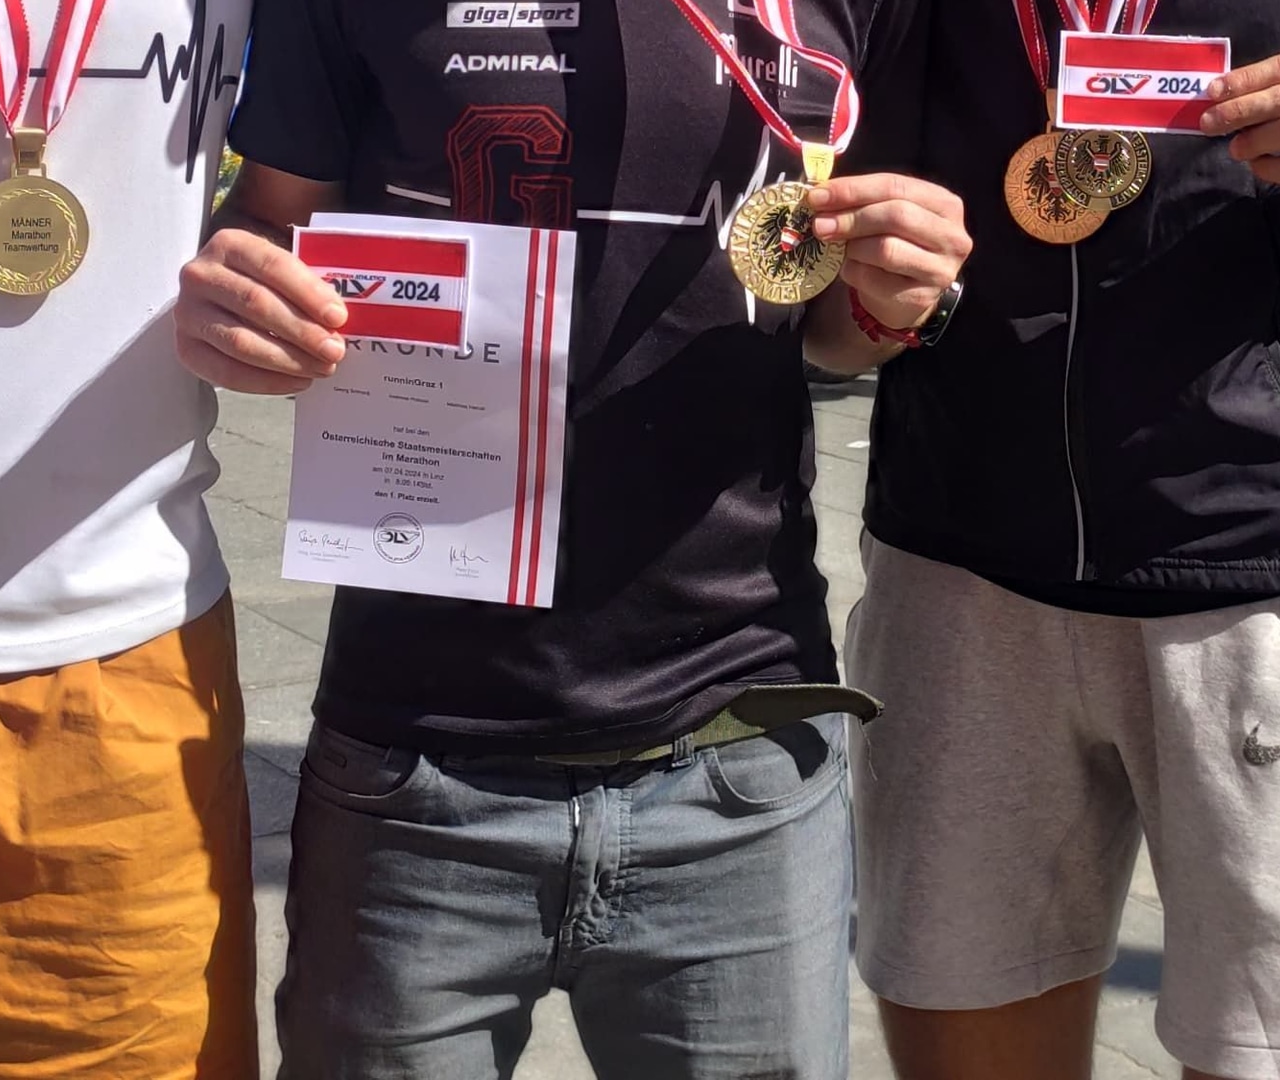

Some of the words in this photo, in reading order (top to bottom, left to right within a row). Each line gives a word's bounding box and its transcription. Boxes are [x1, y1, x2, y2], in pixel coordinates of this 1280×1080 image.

[444, 53, 577, 74] ADMIRAL
[1158, 77, 1201, 95] 2024
[11, 230, 51, 240] Marathon
[3, 242, 59, 253] Teamwertung
[392, 280, 440, 302] 2024
[322, 431, 396, 448] Österreichische
[397, 441, 501, 462] Staatsmeisterschaften
[396, 454, 440, 467] Marathon
